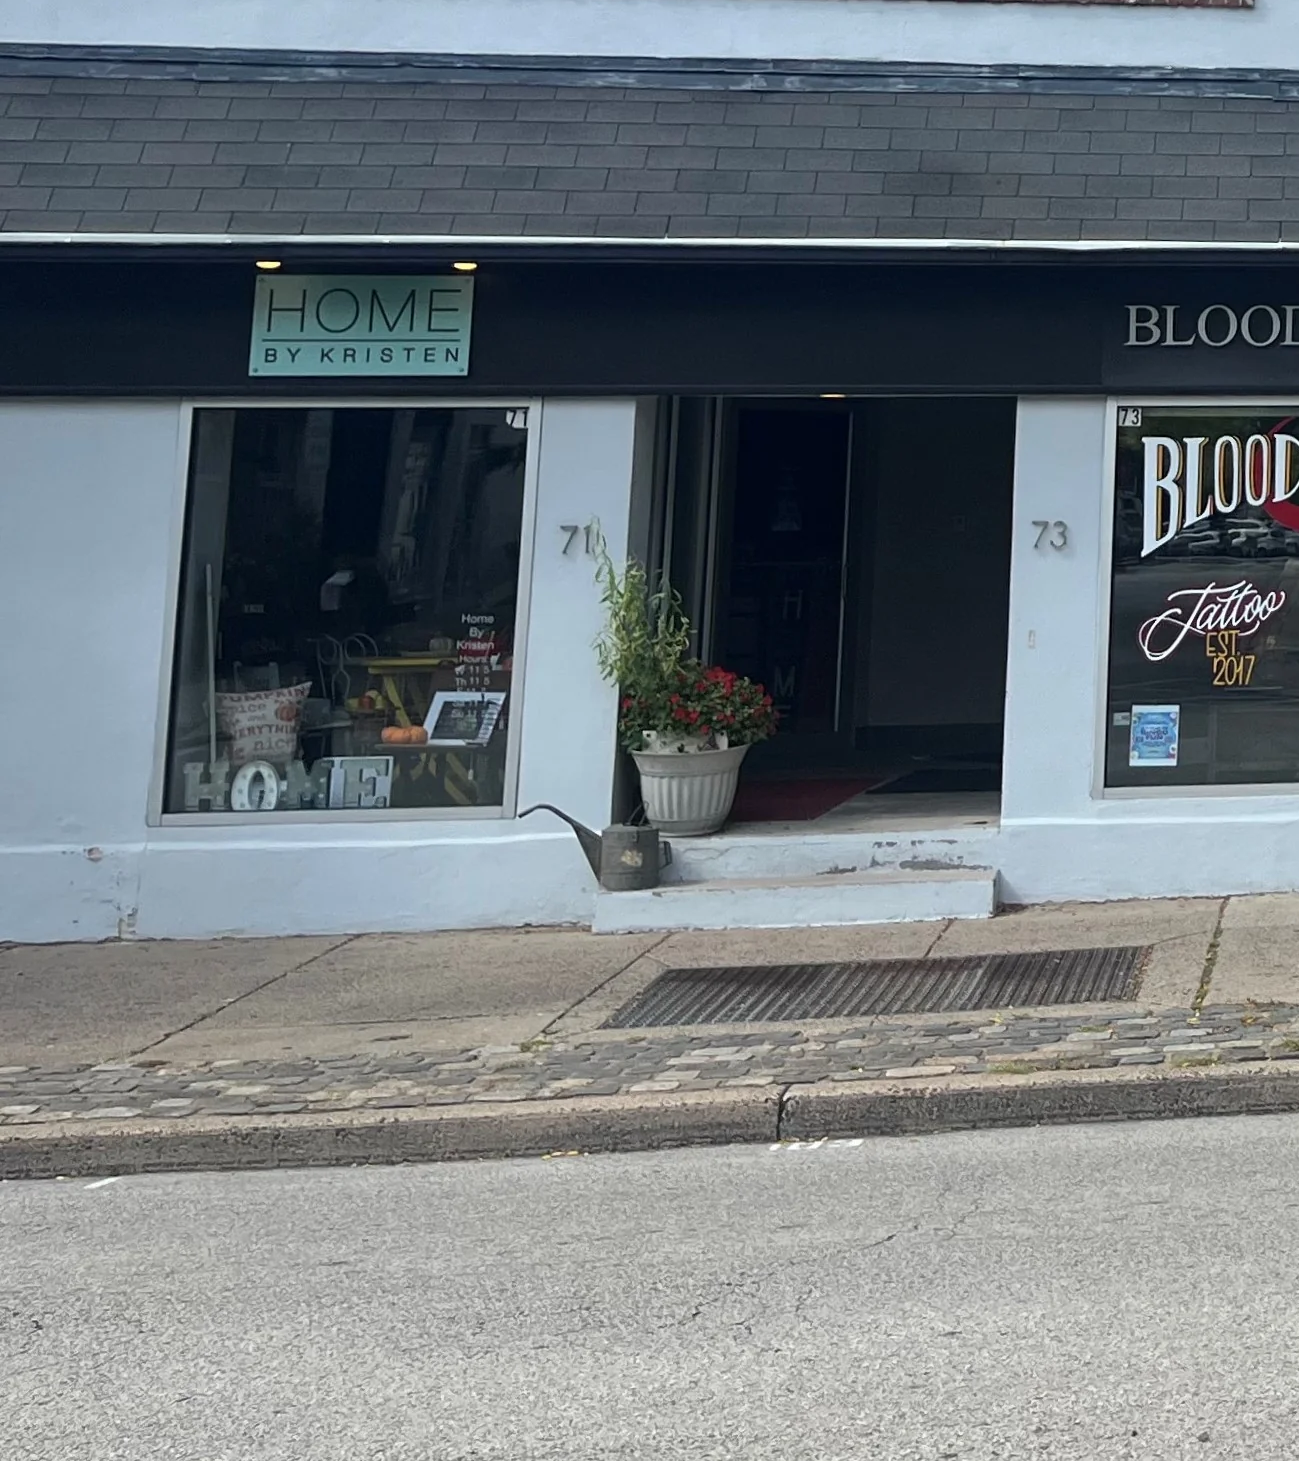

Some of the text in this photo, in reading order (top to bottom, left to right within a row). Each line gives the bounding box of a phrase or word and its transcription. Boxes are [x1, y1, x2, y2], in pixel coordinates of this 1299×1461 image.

[266, 288, 462, 333] HOME
[264, 347, 459, 363] BY KRISTEN
[508, 409, 528, 426] 71
[1120, 408, 1139, 426] 73
[559, 525, 592, 555] 71
[1031, 520, 1068, 550] 73
[461, 613, 495, 624] Home
[1139, 579, 1286, 661] Tattoo
[456, 641, 495, 650] Kristen
[469, 627, 485, 639] By
[1206, 630, 1241, 658] EST.
[1213, 655, 1255, 686] 2017
[183, 754, 394, 812] HOME
